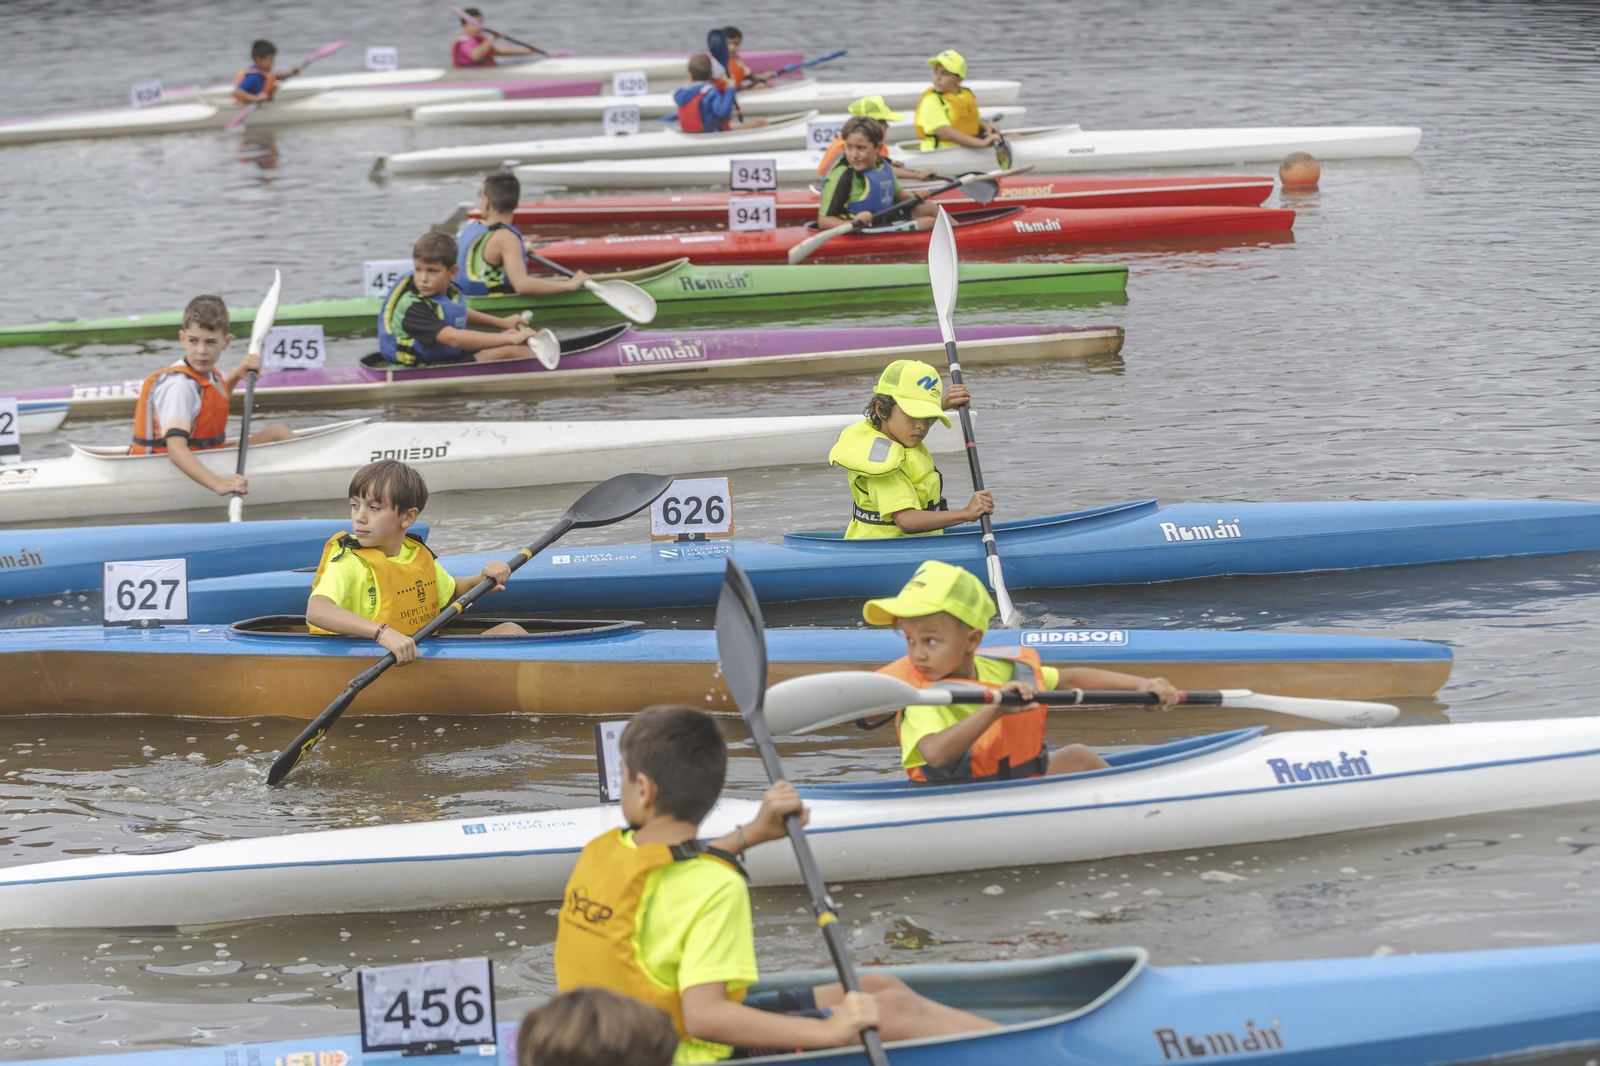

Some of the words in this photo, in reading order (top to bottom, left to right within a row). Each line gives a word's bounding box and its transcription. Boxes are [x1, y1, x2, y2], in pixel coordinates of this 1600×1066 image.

[738, 168, 772, 183] 943
[737, 206, 771, 224] 941
[273, 339, 318, 360] 455
[662, 495, 725, 526] 626
[117, 579, 181, 610] 627
[1026, 631, 1124, 643] BIDASOA
[384, 986, 485, 1029] 456
